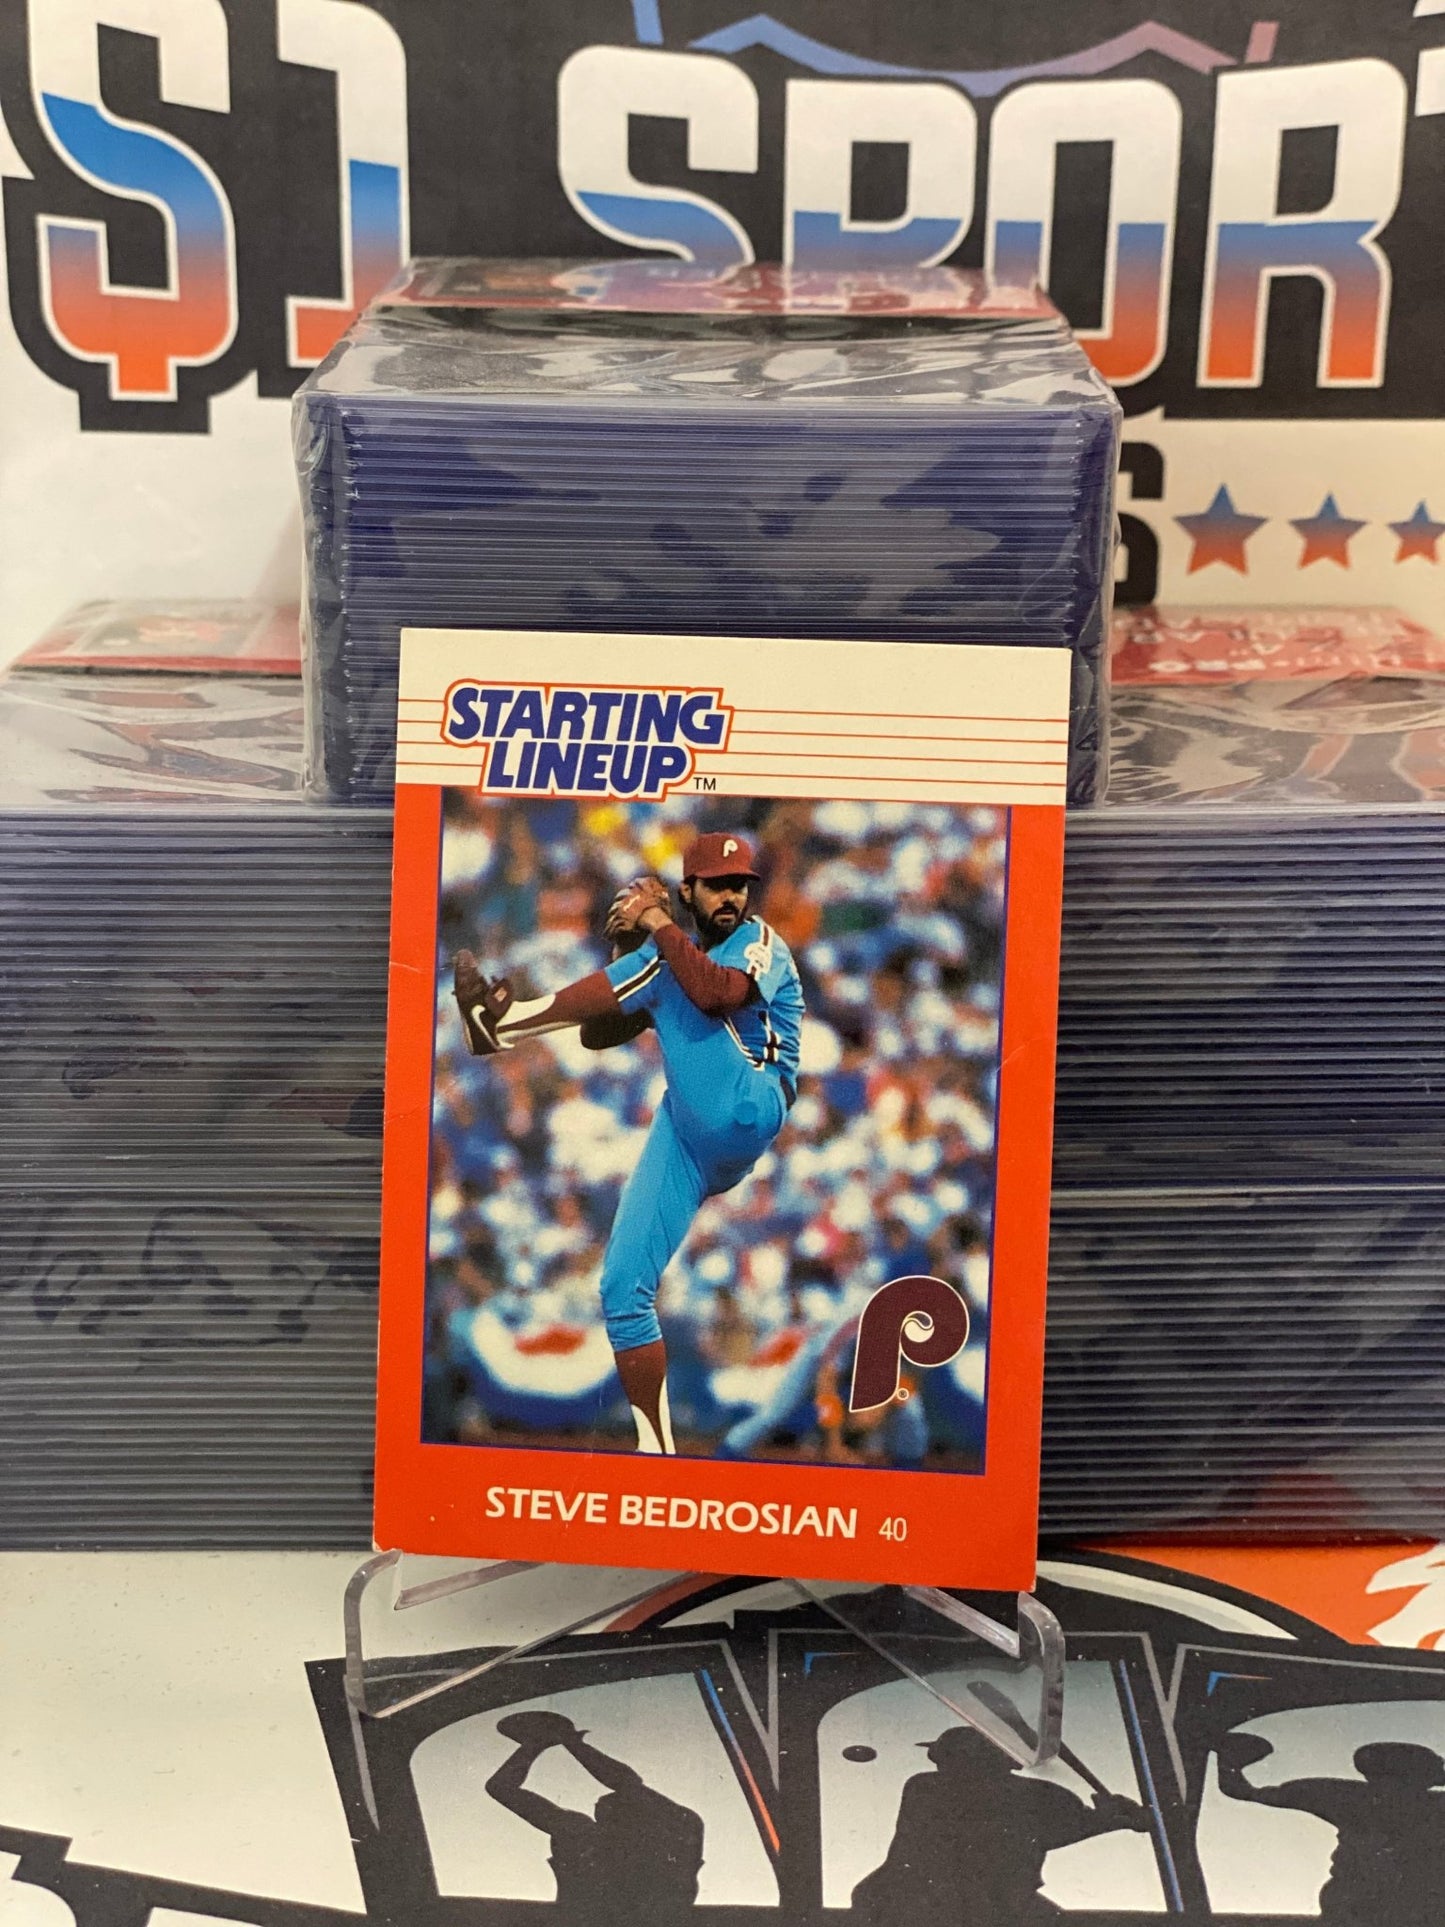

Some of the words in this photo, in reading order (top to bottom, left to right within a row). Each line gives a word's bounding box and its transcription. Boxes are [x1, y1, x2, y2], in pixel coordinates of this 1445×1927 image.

[557, 44, 1445, 389] SPOR
[448, 686, 726, 745] STARTING
[486, 740, 688, 794] LINEUP
[485, 1486, 609, 1524] STEVE
[619, 1494, 858, 1539] BEDROSIAN
[878, 1517, 907, 1542] 40
